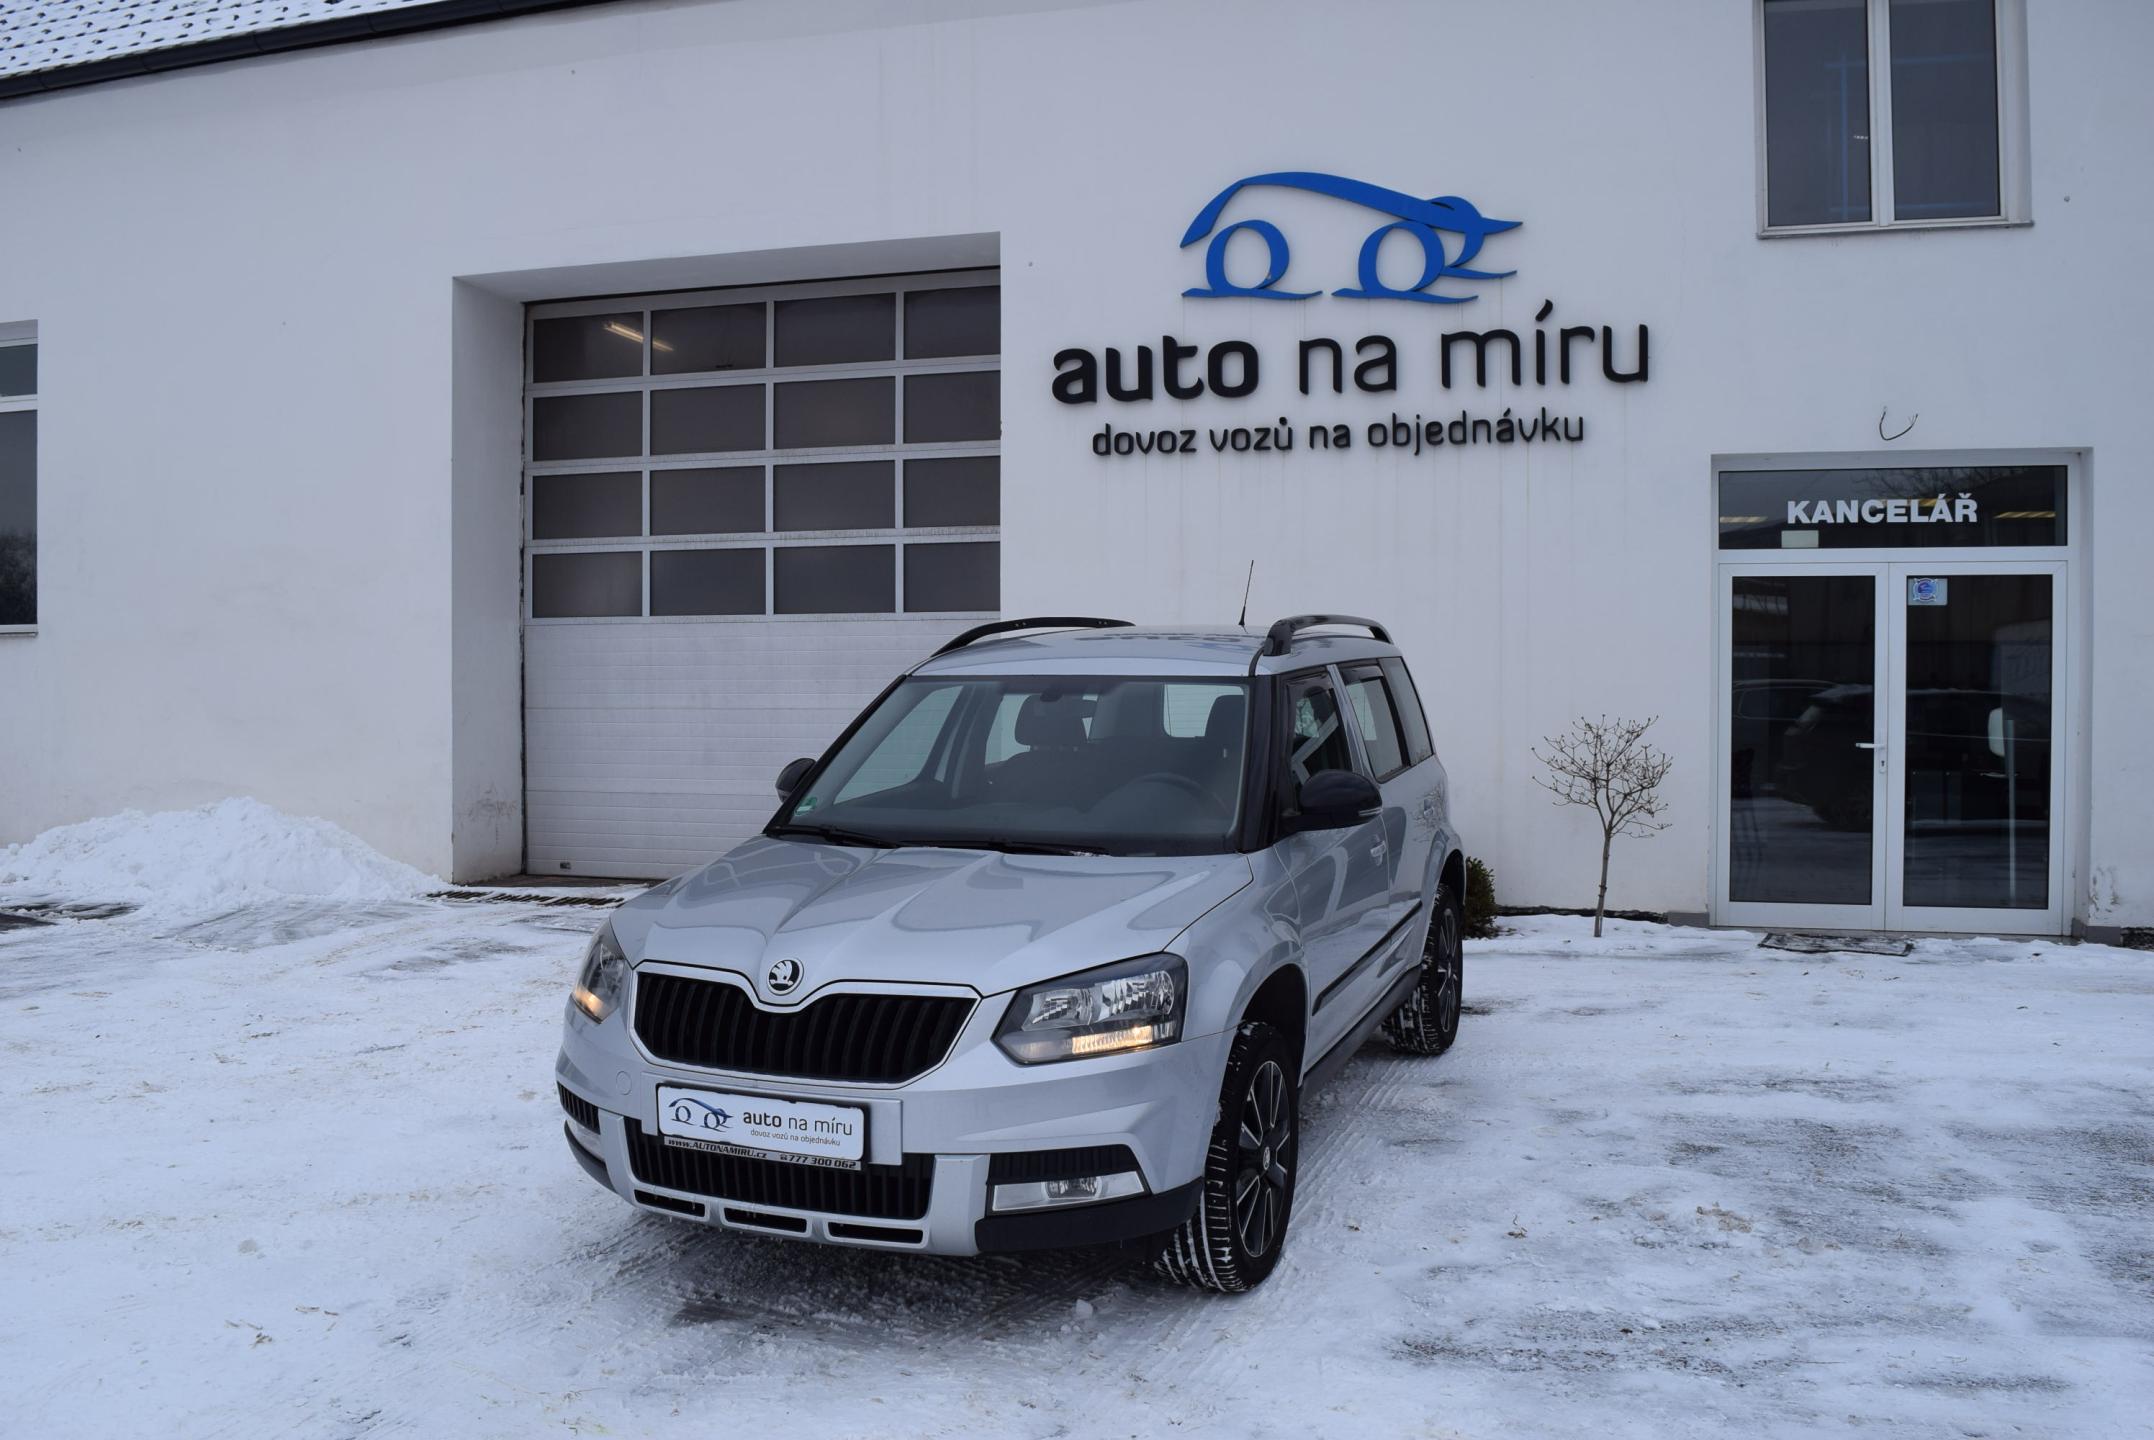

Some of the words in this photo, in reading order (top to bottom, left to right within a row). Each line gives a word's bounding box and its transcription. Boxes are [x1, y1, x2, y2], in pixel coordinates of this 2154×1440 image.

[1052, 335, 1259, 404] auto
[1299, 335, 1397, 395] na
[1441, 299, 1649, 388] míru
[1092, 423, 1197, 456] dovoz
[1210, 417, 1293, 451] vozů
[1309, 424, 1351, 449] na
[1368, 407, 1584, 456] objednávku
[1787, 493, 1978, 524] KANCELÁŘ
[743, 1112, 782, 1127] auto
[788, 1117, 807, 1131] na
[814, 1117, 852, 1136] míru
[750, 1128, 770, 1137] dovoz
[811, 1157, 832, 1167] 300
